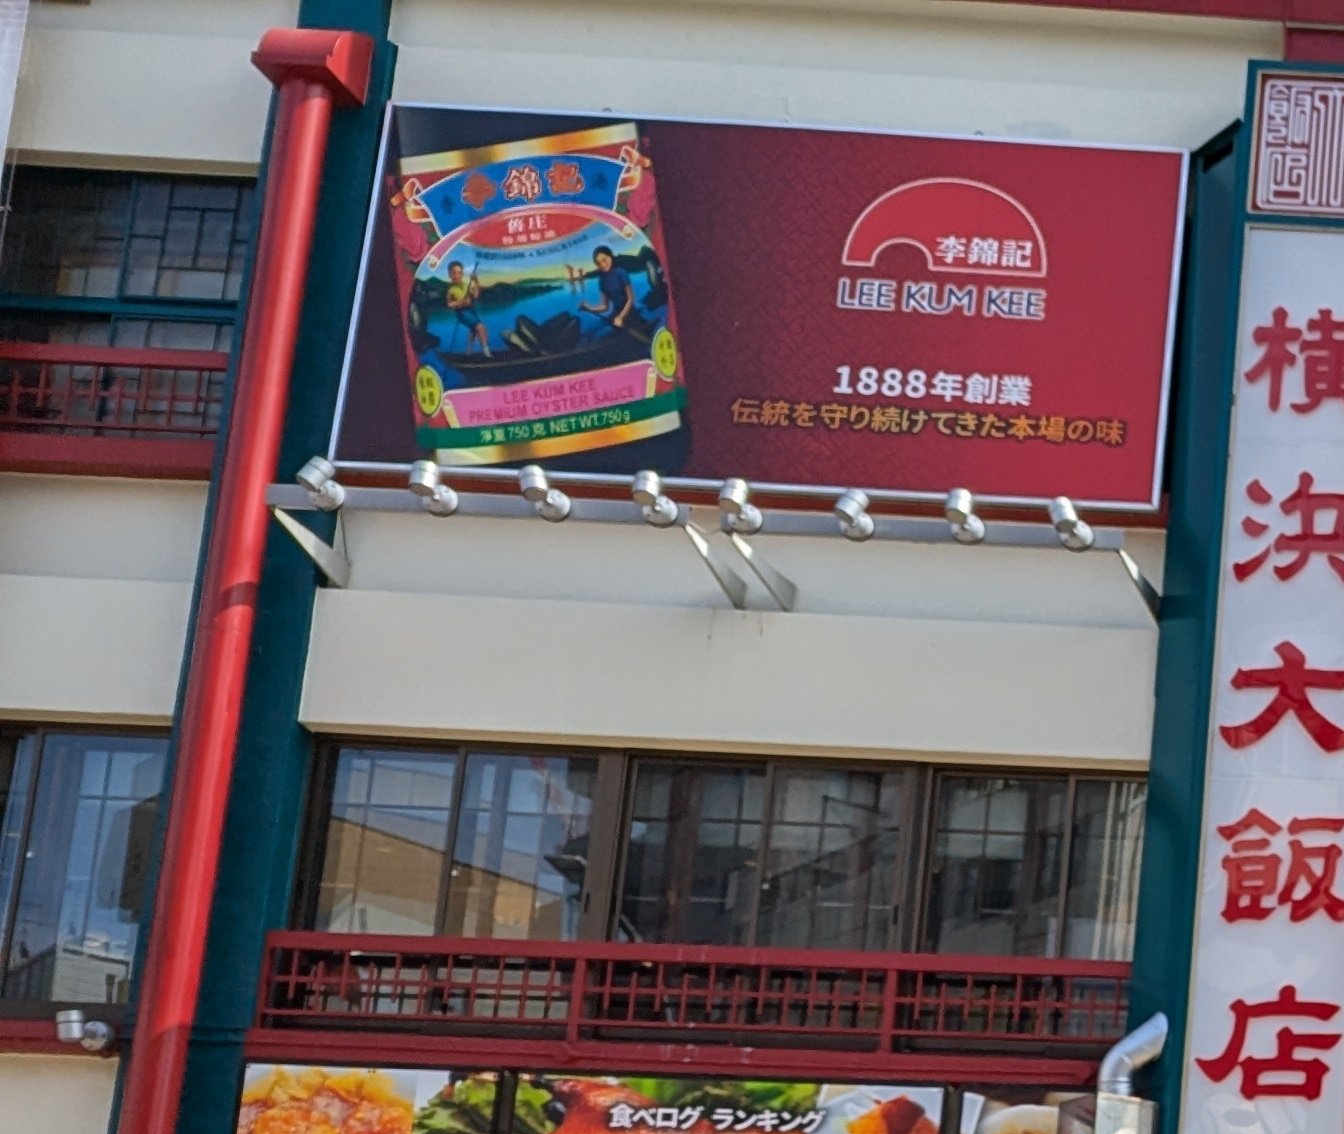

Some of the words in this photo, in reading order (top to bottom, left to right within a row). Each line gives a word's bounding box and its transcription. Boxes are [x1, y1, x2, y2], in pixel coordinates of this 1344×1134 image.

[935, 236, 1032, 268] 李錦記
[837, 277, 894, 310] LEE
[902, 281, 976, 316] KUM
[983, 285, 1047, 320] KEE
[832, 364, 1033, 407] 1888年創業
[731, 398, 1126, 446] 伝統を守り続けてきた本場の味
[609, 1104, 702, 1130] 食べログ
[713, 1108, 825, 1133] ランキング
